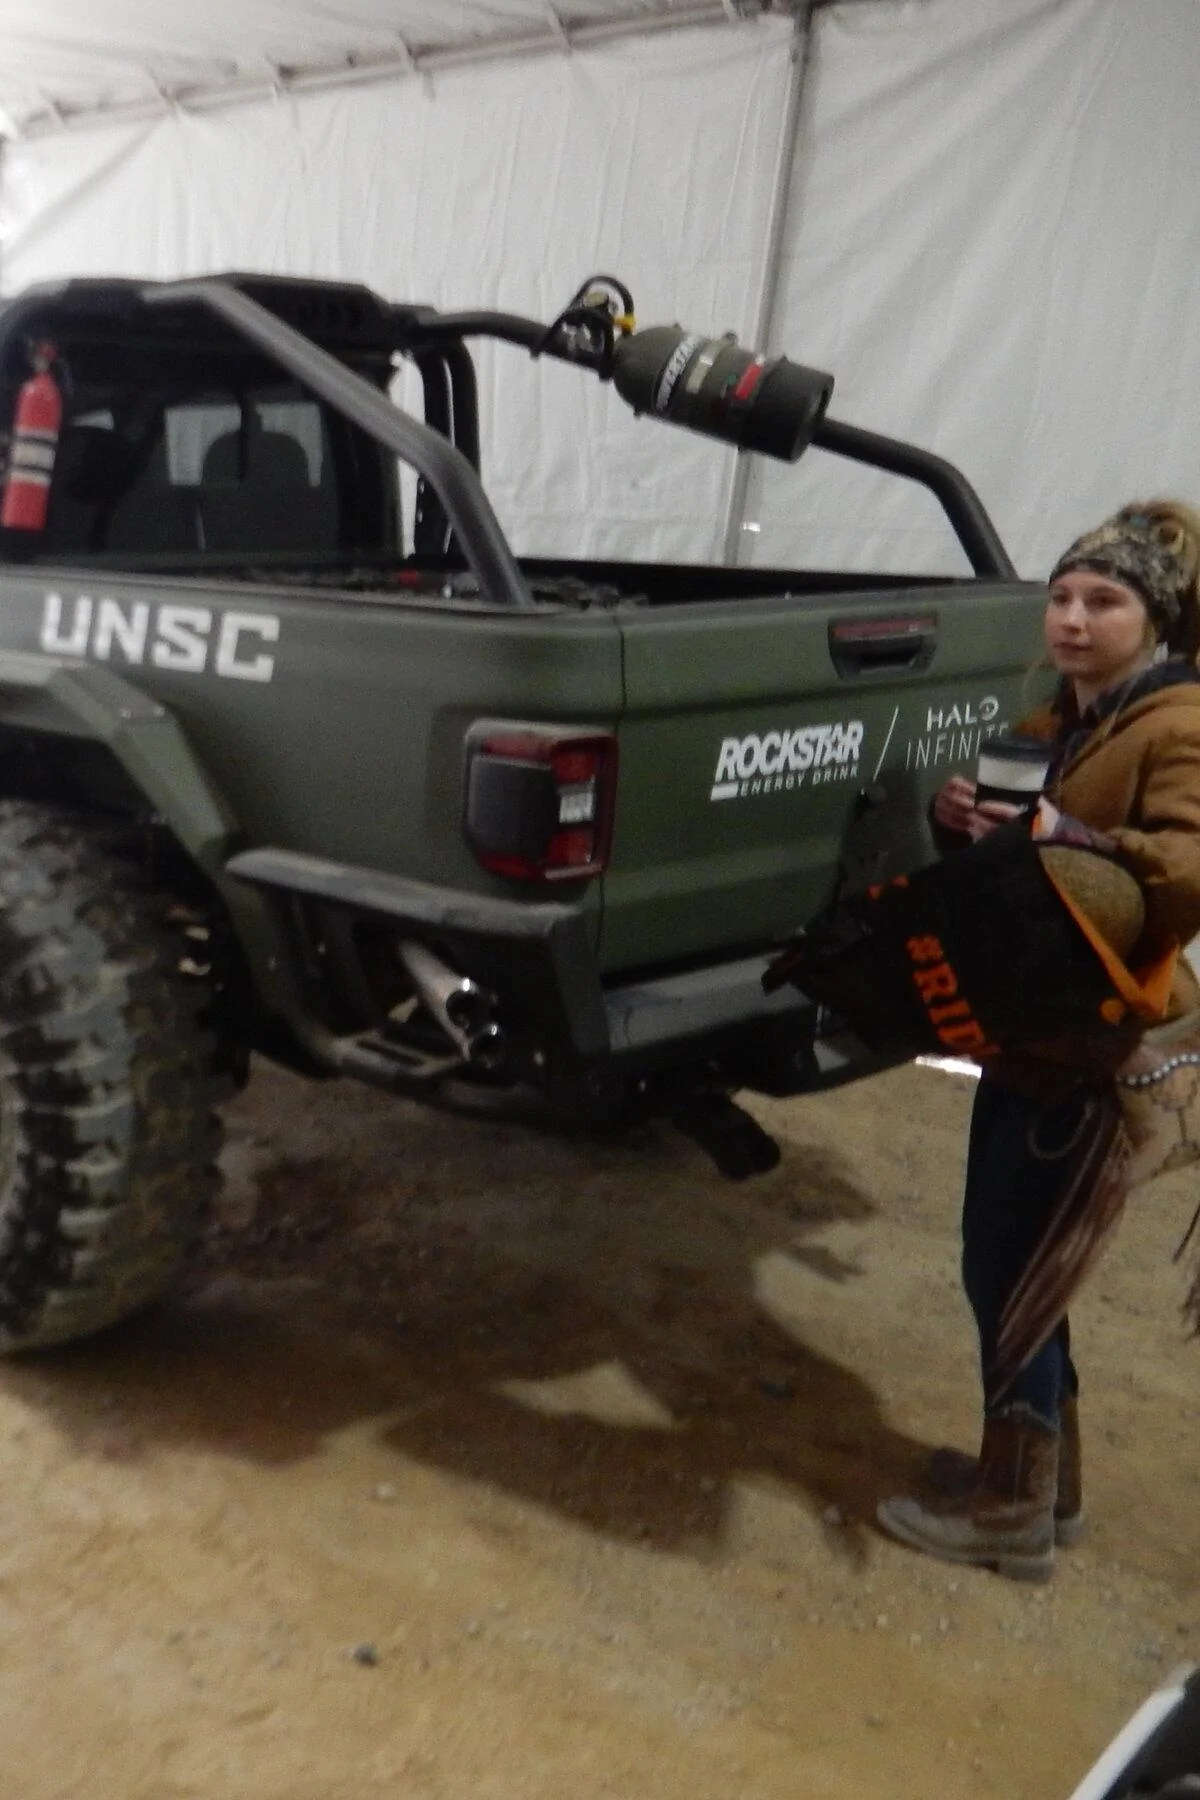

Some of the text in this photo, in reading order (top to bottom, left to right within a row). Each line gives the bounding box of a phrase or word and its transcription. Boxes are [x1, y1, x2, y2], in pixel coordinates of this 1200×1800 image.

[41, 592, 280, 682] UNSC
[926, 696, 999, 732] HALO
[713, 720, 864, 781] ROCKSTAR
[740, 763, 859, 797] ENERGY DRINK
